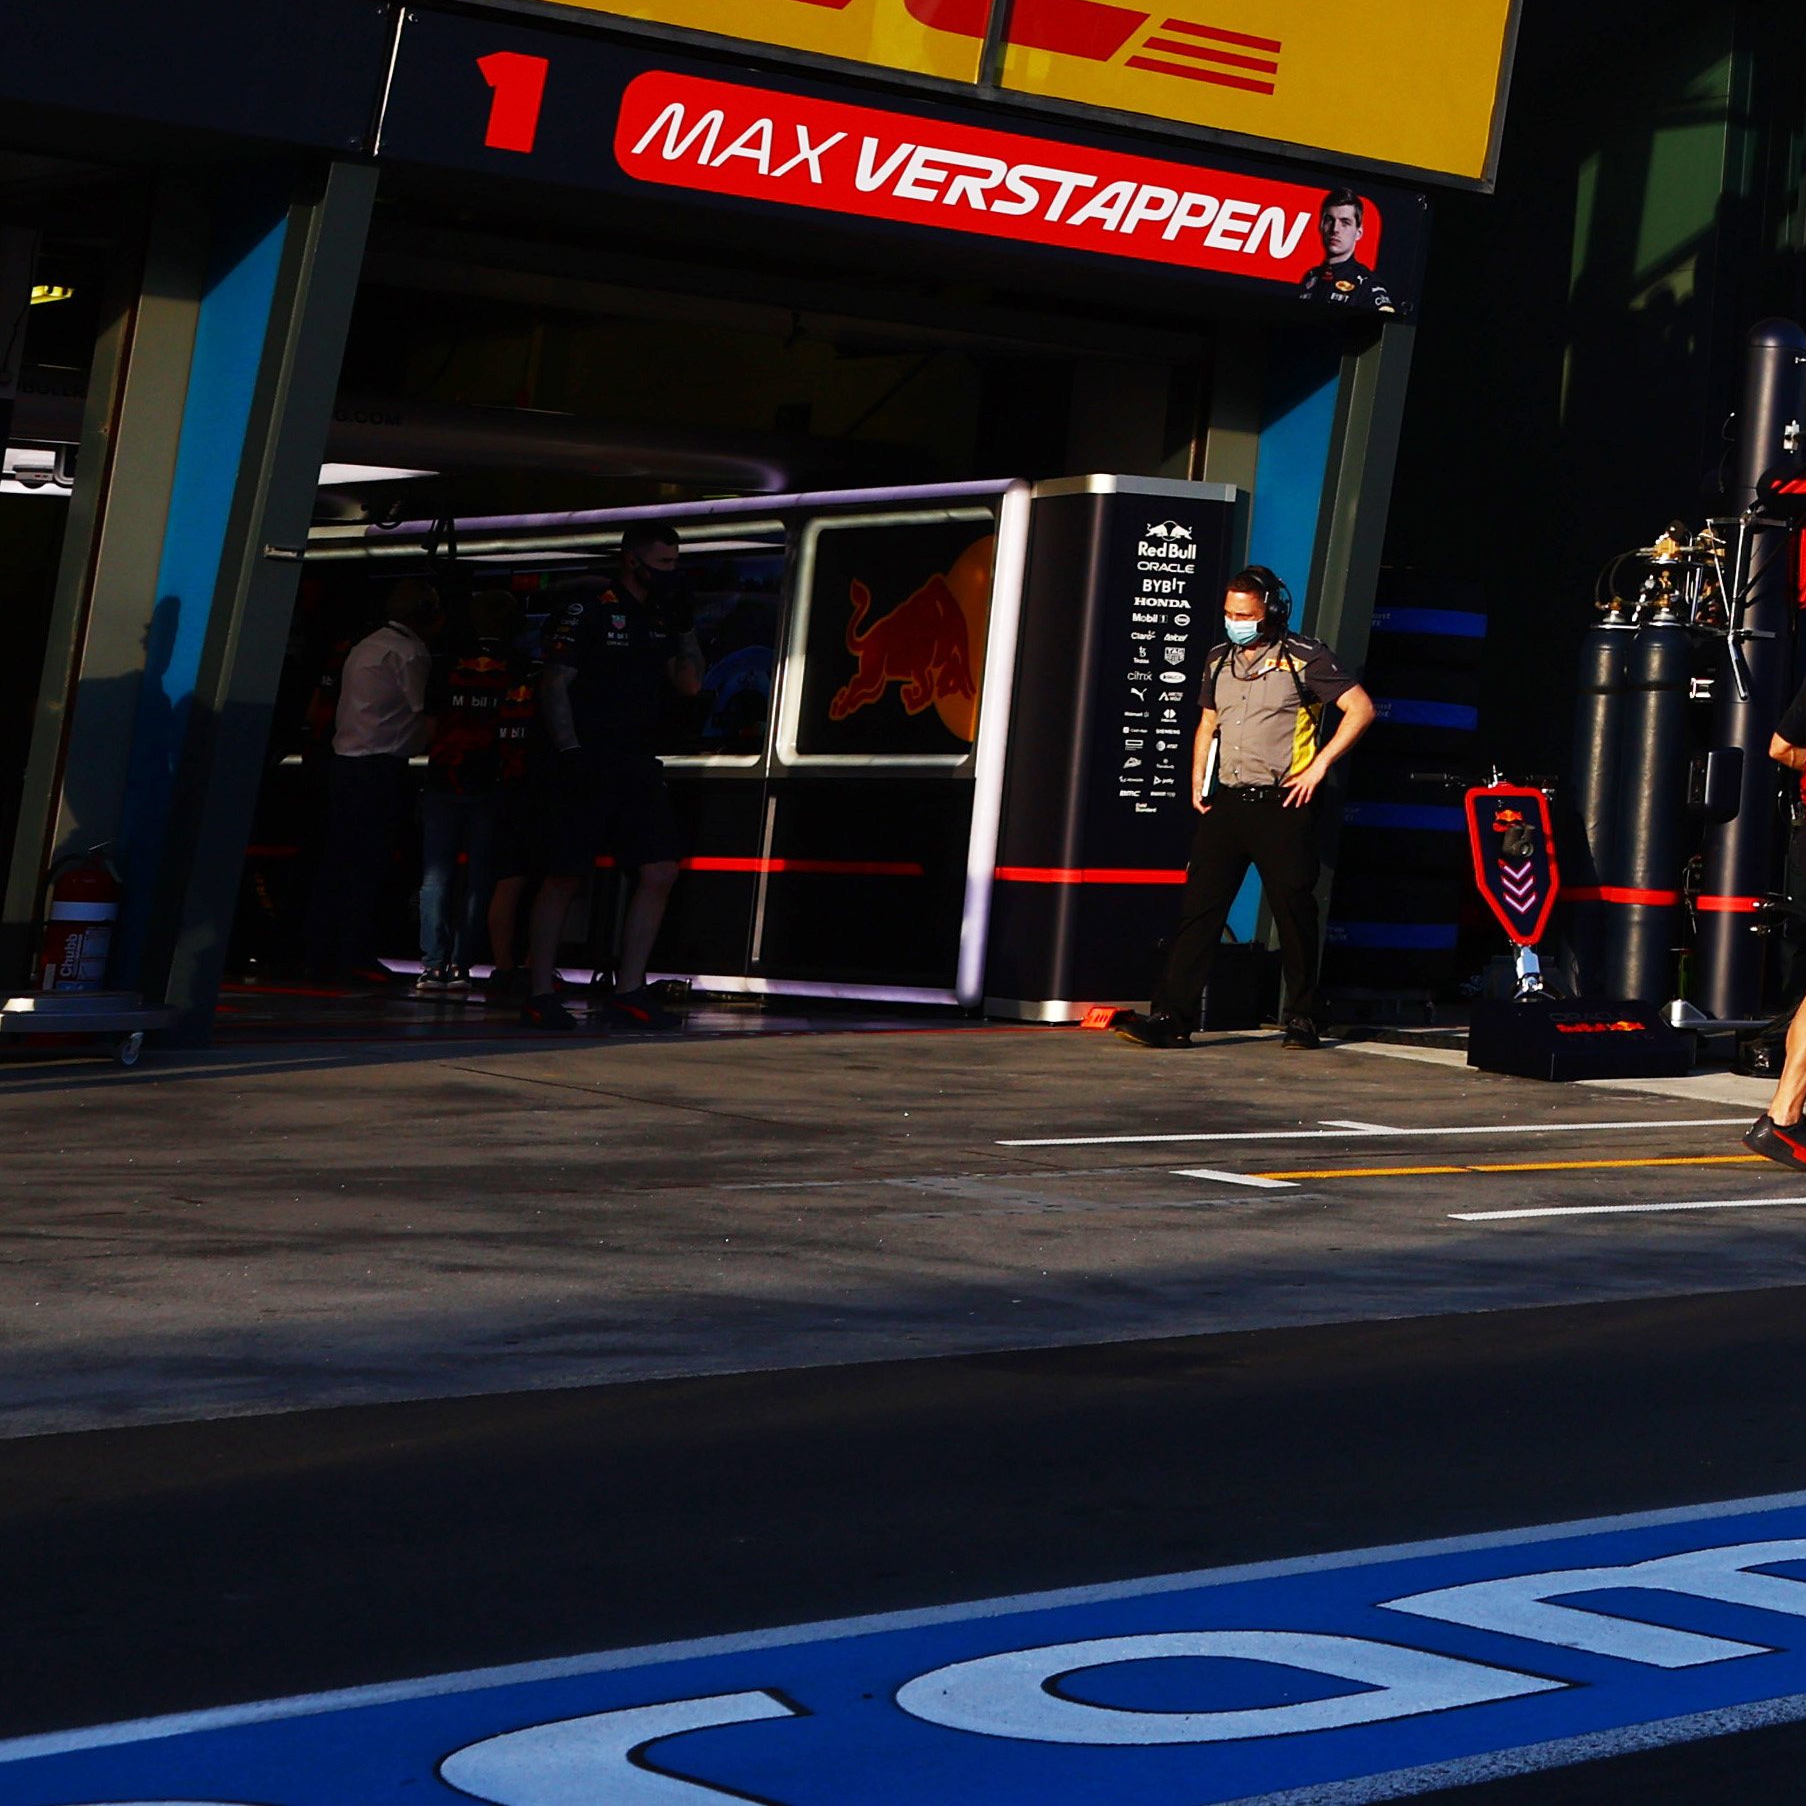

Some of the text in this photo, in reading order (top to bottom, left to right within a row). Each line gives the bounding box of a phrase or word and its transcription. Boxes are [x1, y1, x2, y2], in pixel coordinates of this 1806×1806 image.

[476, 51, 549, 153] 1
[631, 101, 1312, 260] MAX VERSTAPPEN
[1137, 540, 1197, 561] Red Bull
[1136, 560, 1196, 574] ORACLE
[1141, 577, 1187, 595] BYBIT
[1133, 596, 1192, 609] HONDA
[1131, 612, 1159, 624] Mobil
[1126, 670, 1153, 681] citrix
